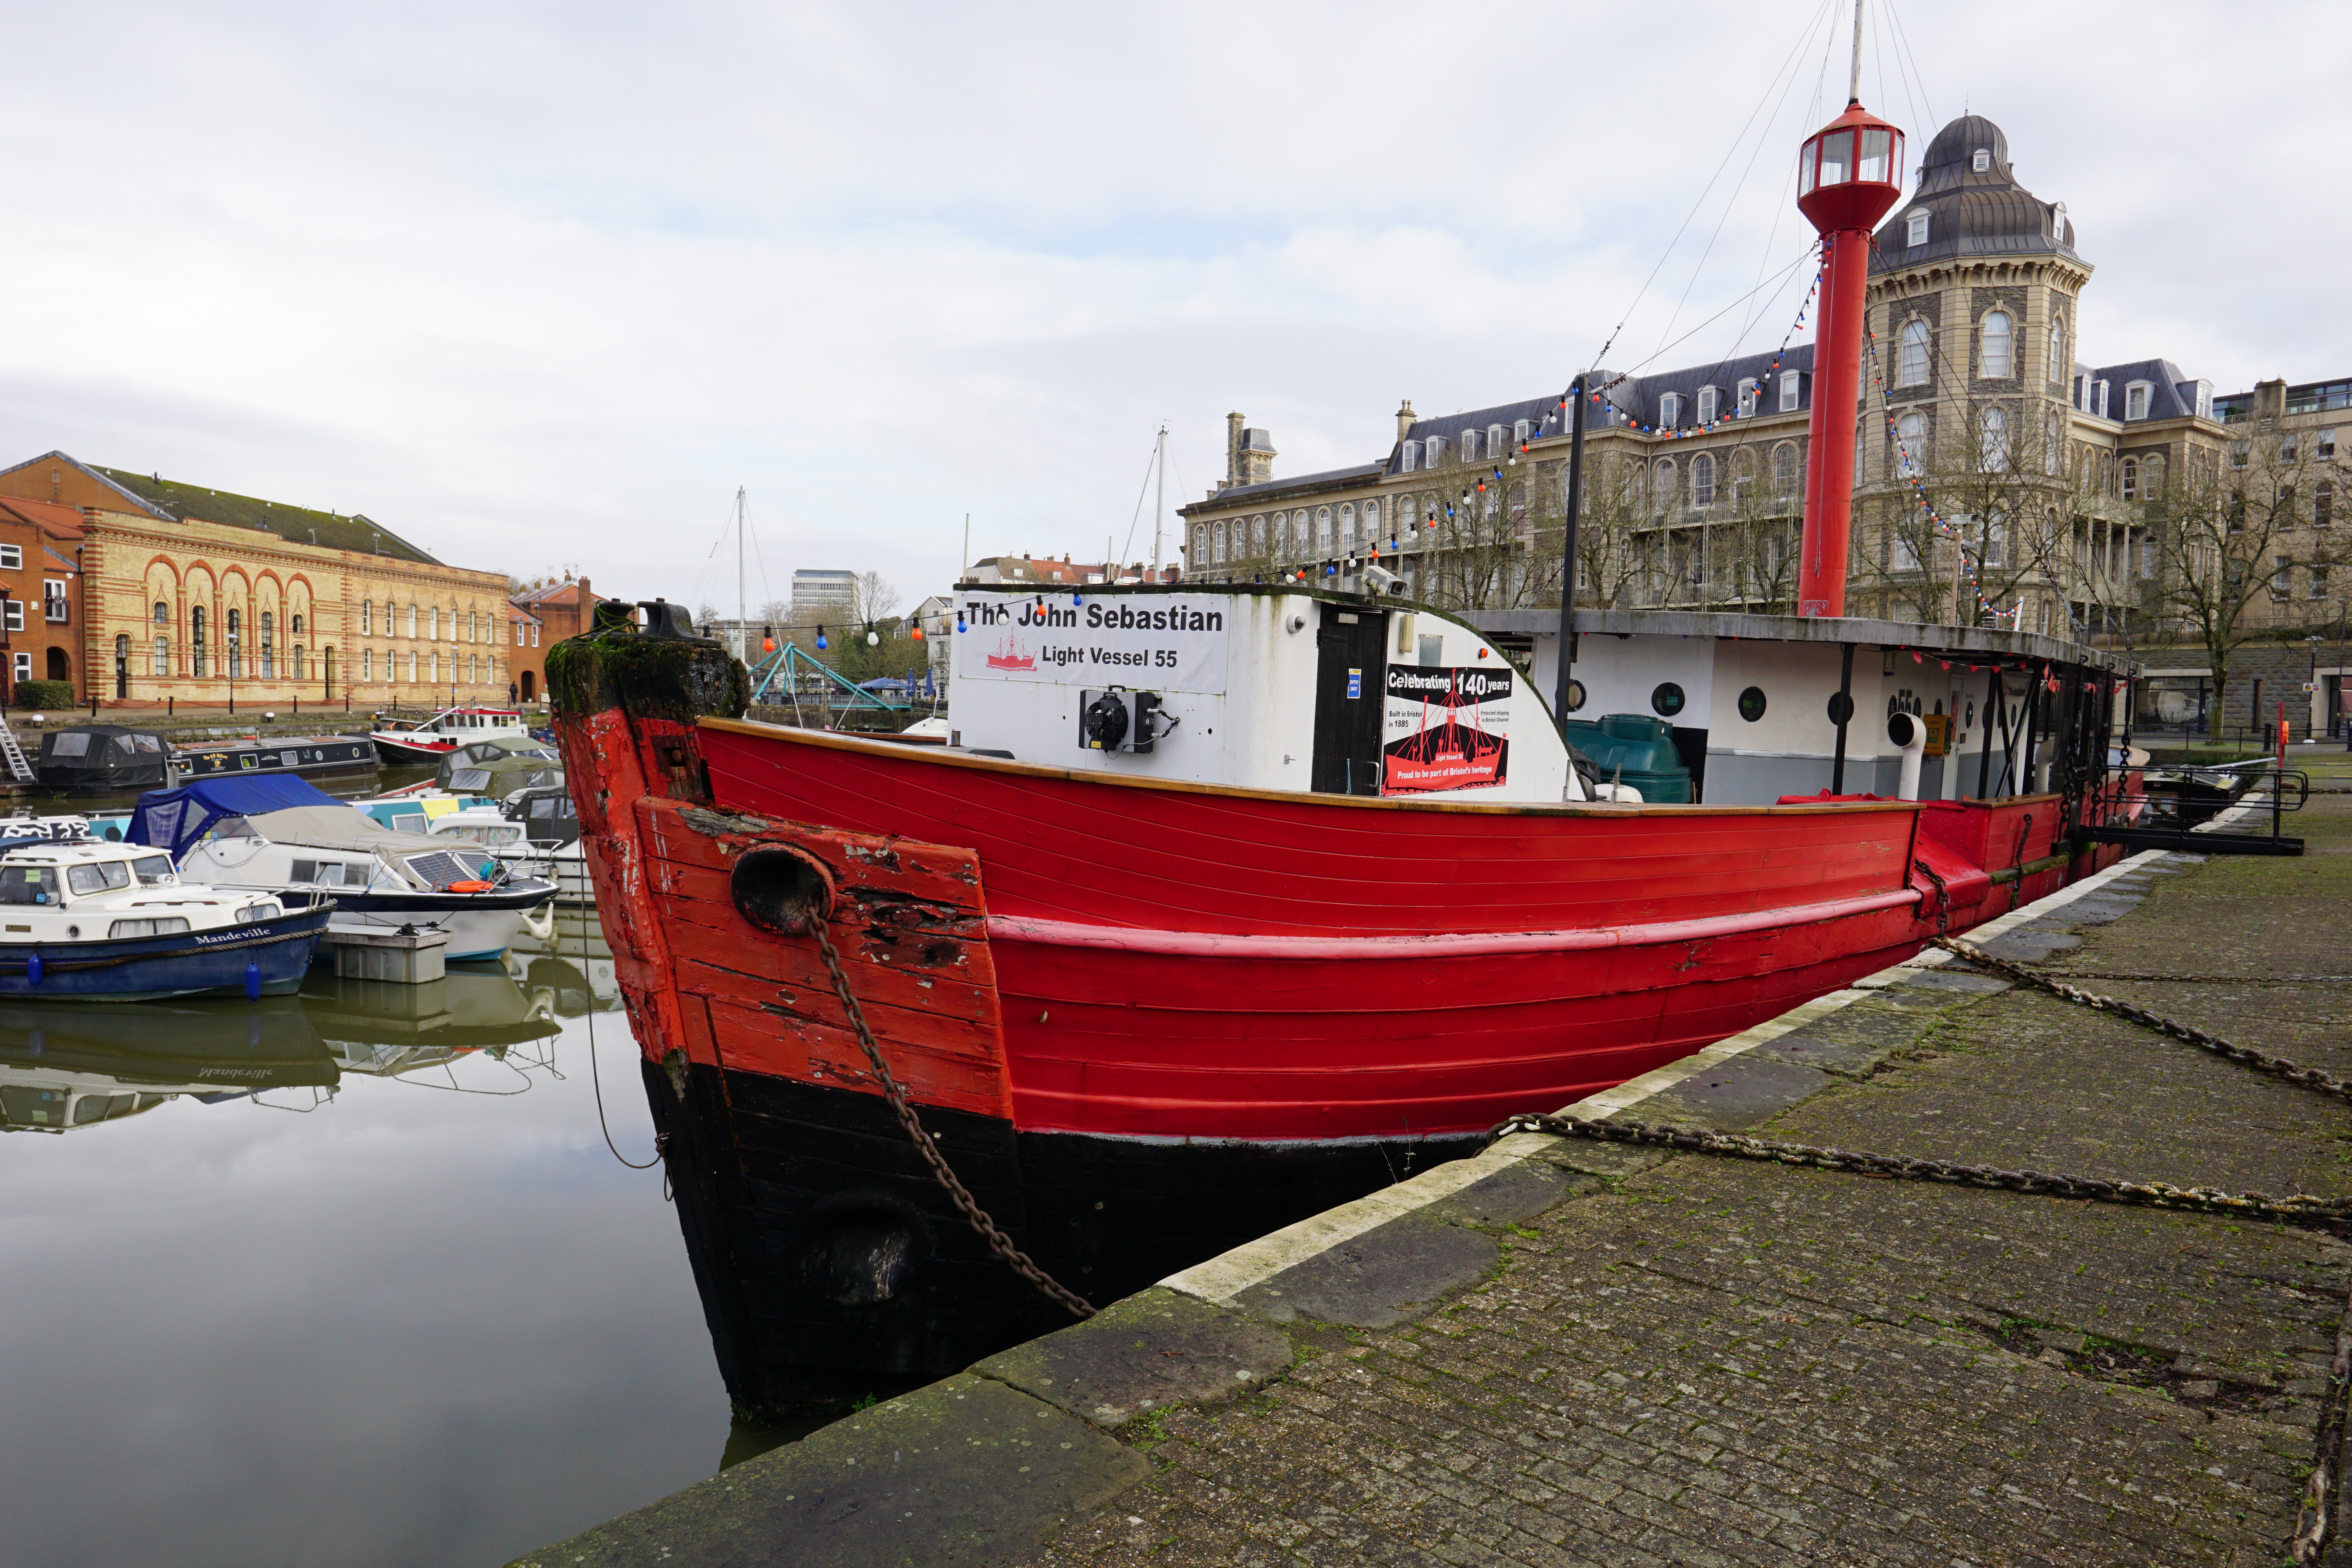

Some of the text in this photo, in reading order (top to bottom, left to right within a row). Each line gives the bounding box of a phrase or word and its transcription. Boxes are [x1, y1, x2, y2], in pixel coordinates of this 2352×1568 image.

[1018, 603, 1076, 627] John
[1087, 603, 1222, 631] Sebastian
[1043, 646, 1177, 668] Light Vessel 55
[1388, 672, 1509, 695] Celebrating 140 years
[1397, 770, 1414, 779] Proud
[1430, 769, 1441, 779] part
[1450, 766, 1471, 776] Bristol's
[1472, 766, 1492, 775] heritage
[194, 928, 271, 944] Mandeville
